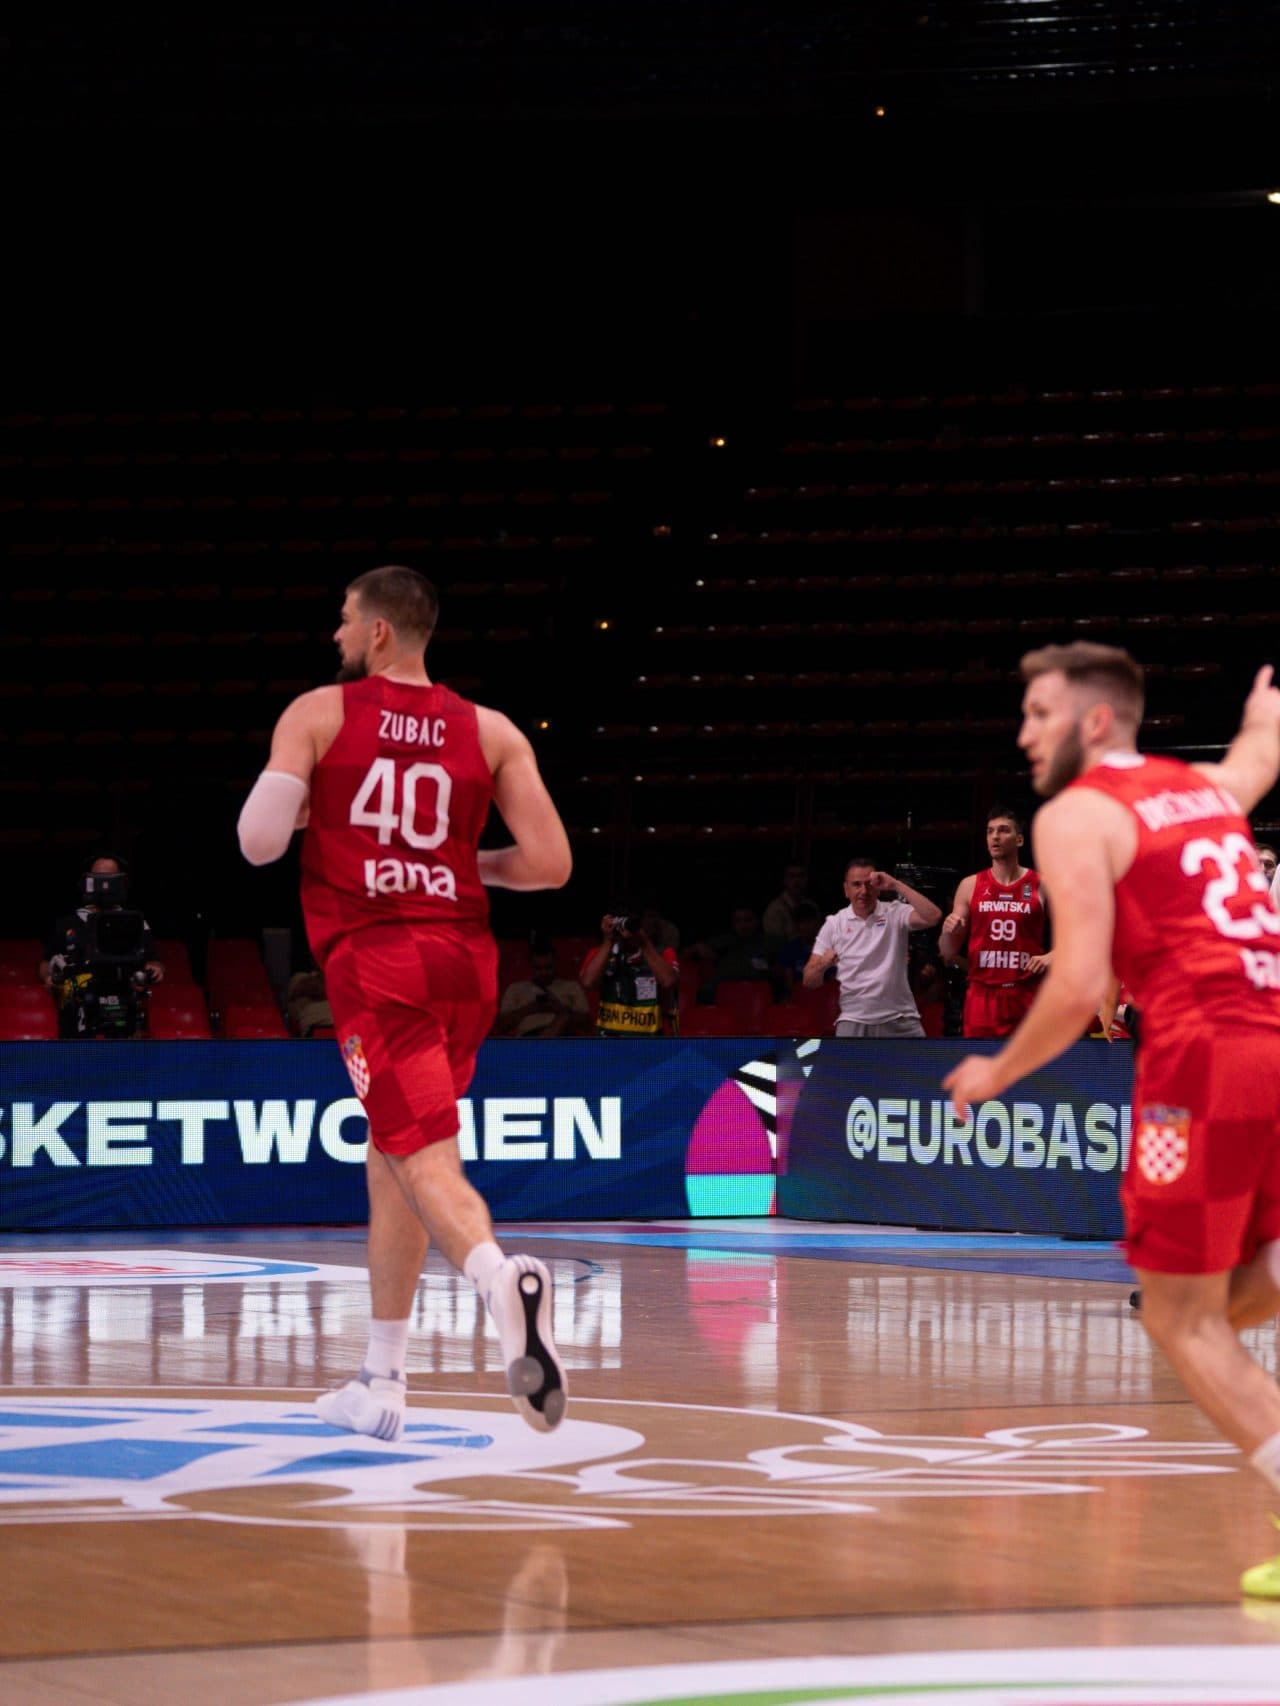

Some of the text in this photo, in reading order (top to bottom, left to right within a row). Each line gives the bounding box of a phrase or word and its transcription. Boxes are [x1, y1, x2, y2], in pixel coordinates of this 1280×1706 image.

[378, 709, 446, 747] ZUBAC
[350, 757, 452, 850] 40
[978, 900, 1031, 915] HRVATSKA
[990, 919, 1016, 942] 99
[0, 1096, 622, 1167] KETWOEN
[846, 1096, 1133, 1173] @EUROBAS
